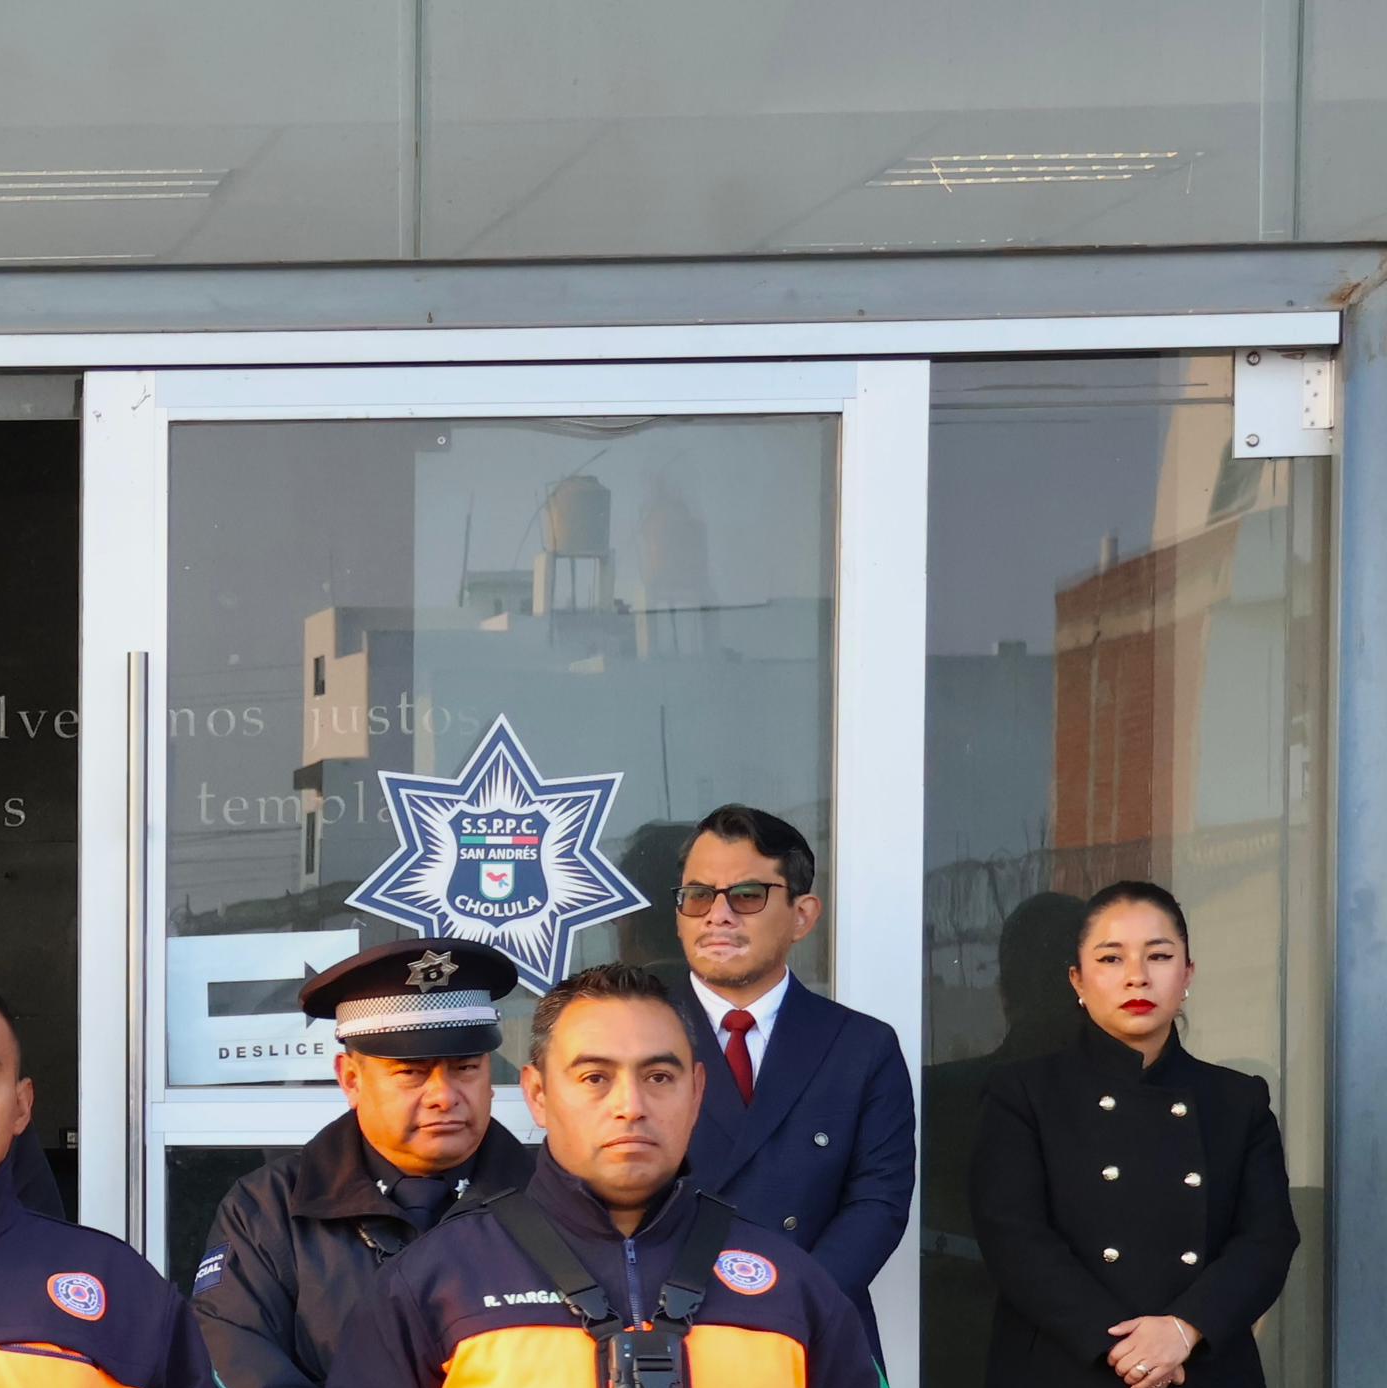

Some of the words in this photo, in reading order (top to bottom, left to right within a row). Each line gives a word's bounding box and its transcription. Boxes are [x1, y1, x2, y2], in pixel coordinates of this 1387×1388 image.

[461, 817, 537, 835] S.S.P.P.C.
[459, 847, 485, 860] SAN
[487, 844, 538, 860] ANDRÉS
[454, 894, 542, 917] CHOLULA
[218, 1042, 324, 1060] DESLICE
[503, 1289, 562, 1305] VARGA
